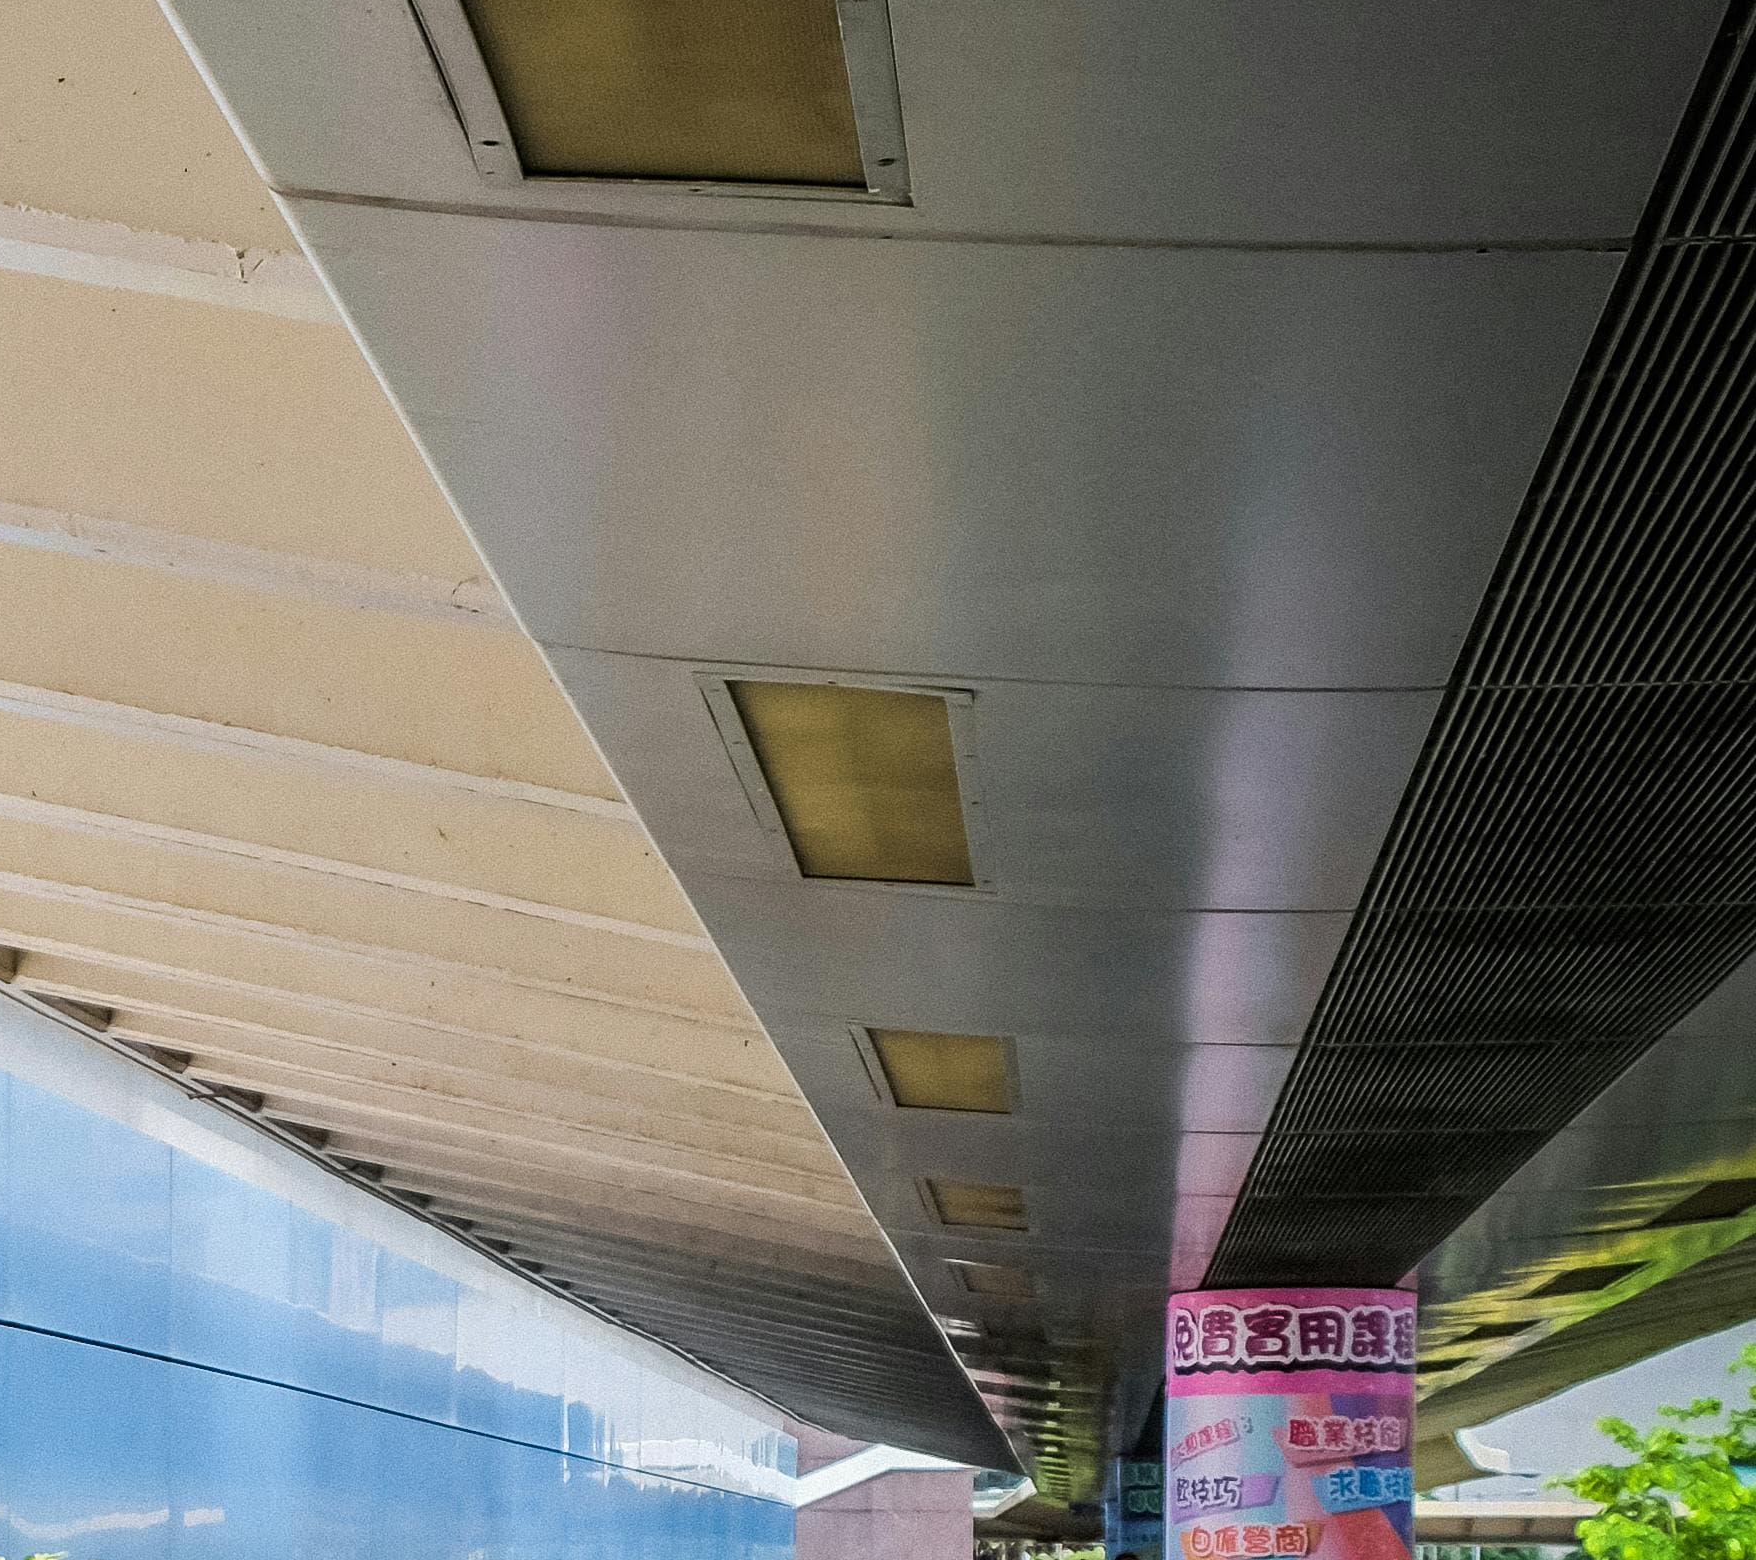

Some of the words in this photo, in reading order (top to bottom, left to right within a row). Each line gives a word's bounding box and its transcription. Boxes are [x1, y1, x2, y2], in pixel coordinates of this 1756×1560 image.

[1288, 1418, 1401, 1448] 職業技能
[1191, 1525, 1307, 1555] 自僱營商
